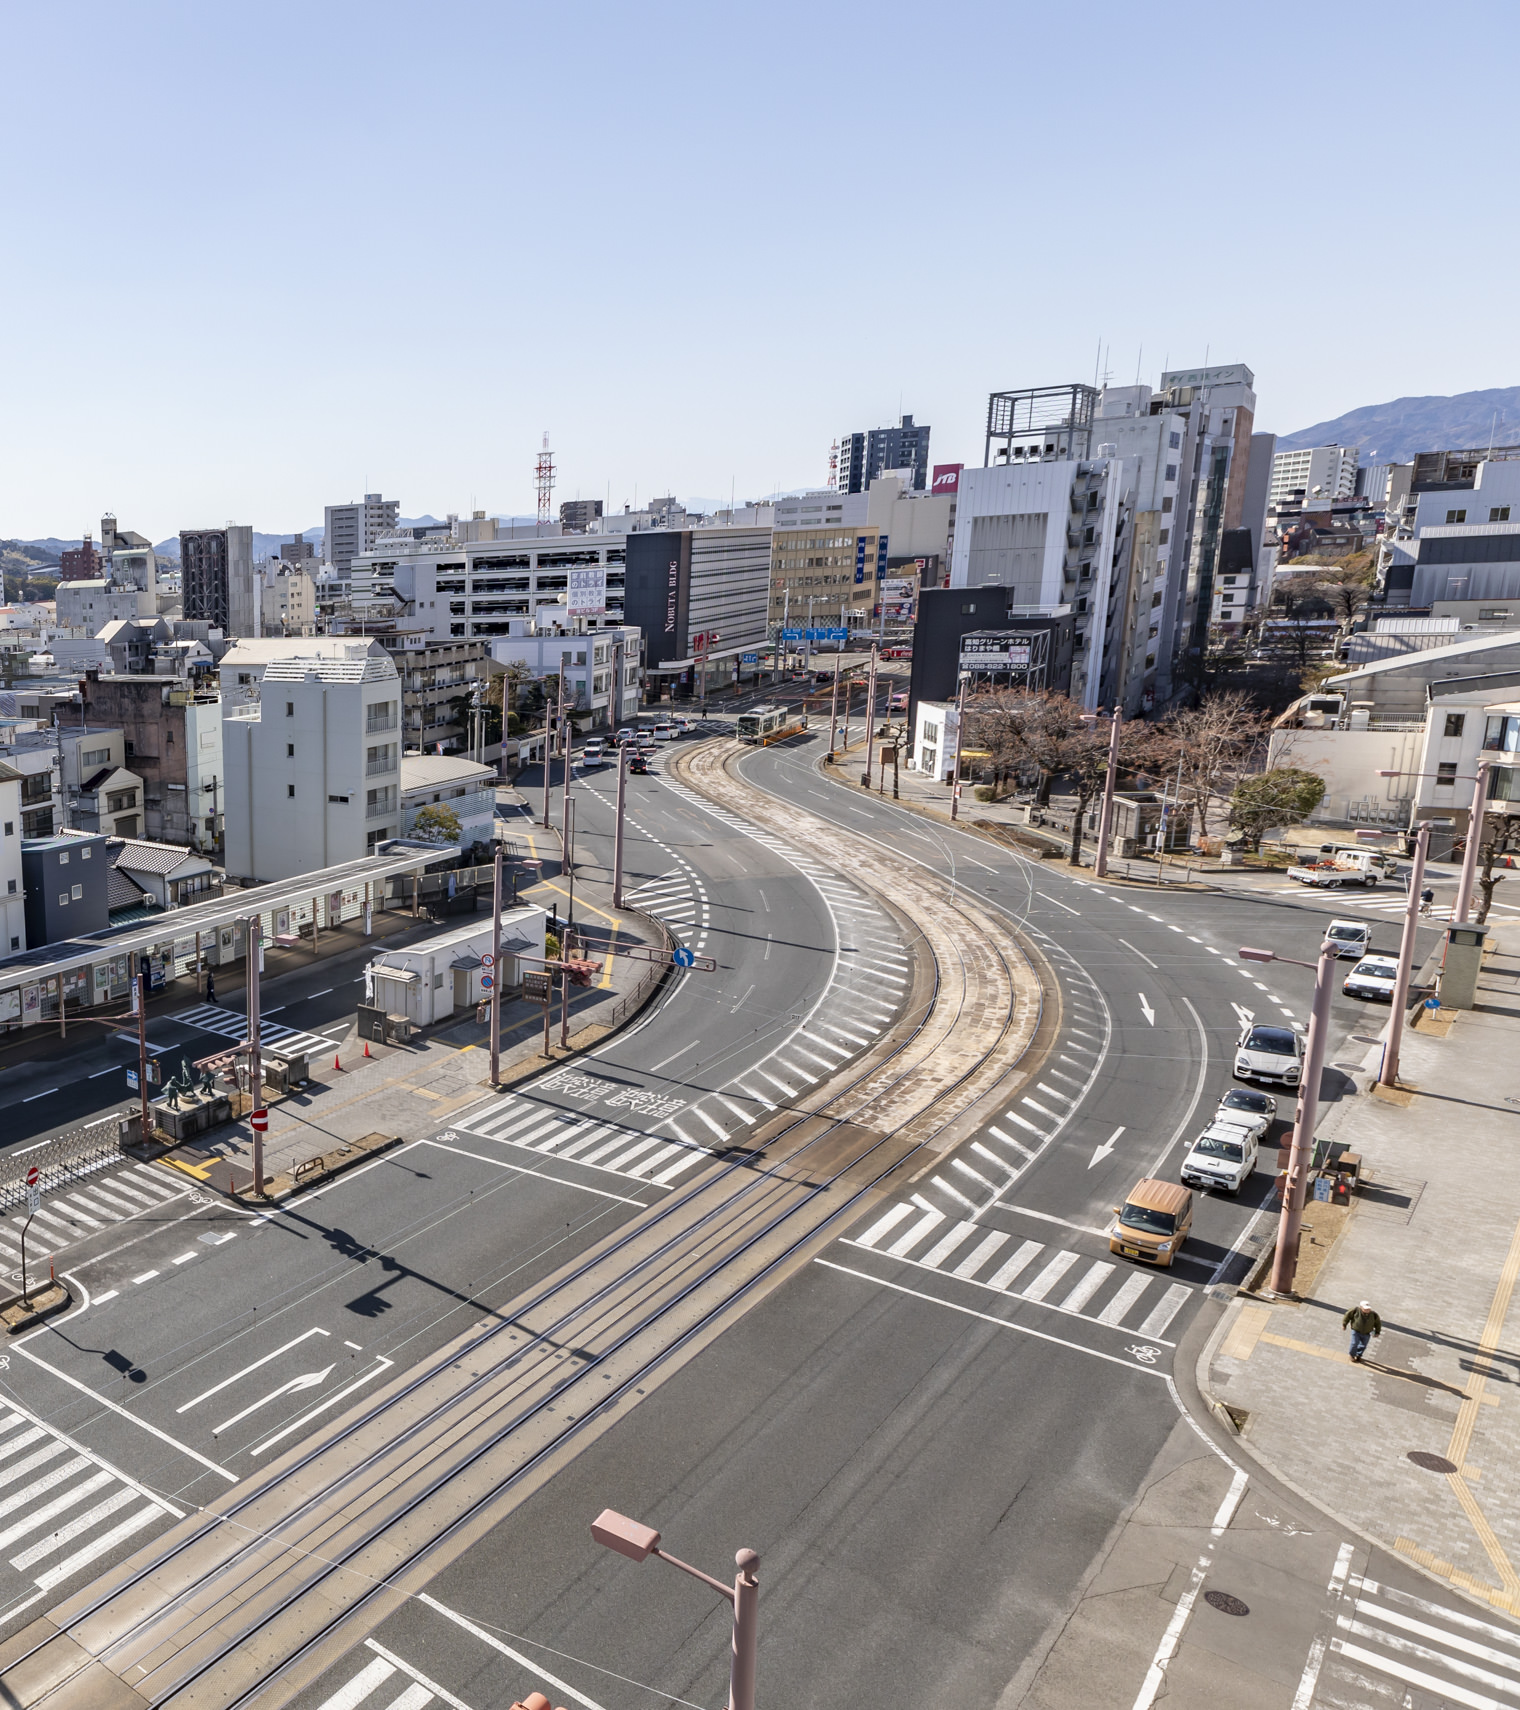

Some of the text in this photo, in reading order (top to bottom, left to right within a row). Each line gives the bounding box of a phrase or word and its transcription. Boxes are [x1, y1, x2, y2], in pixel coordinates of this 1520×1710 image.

[933, 472, 957, 486] JTB
[665, 561, 678, 632] NOBUTA BLDG
